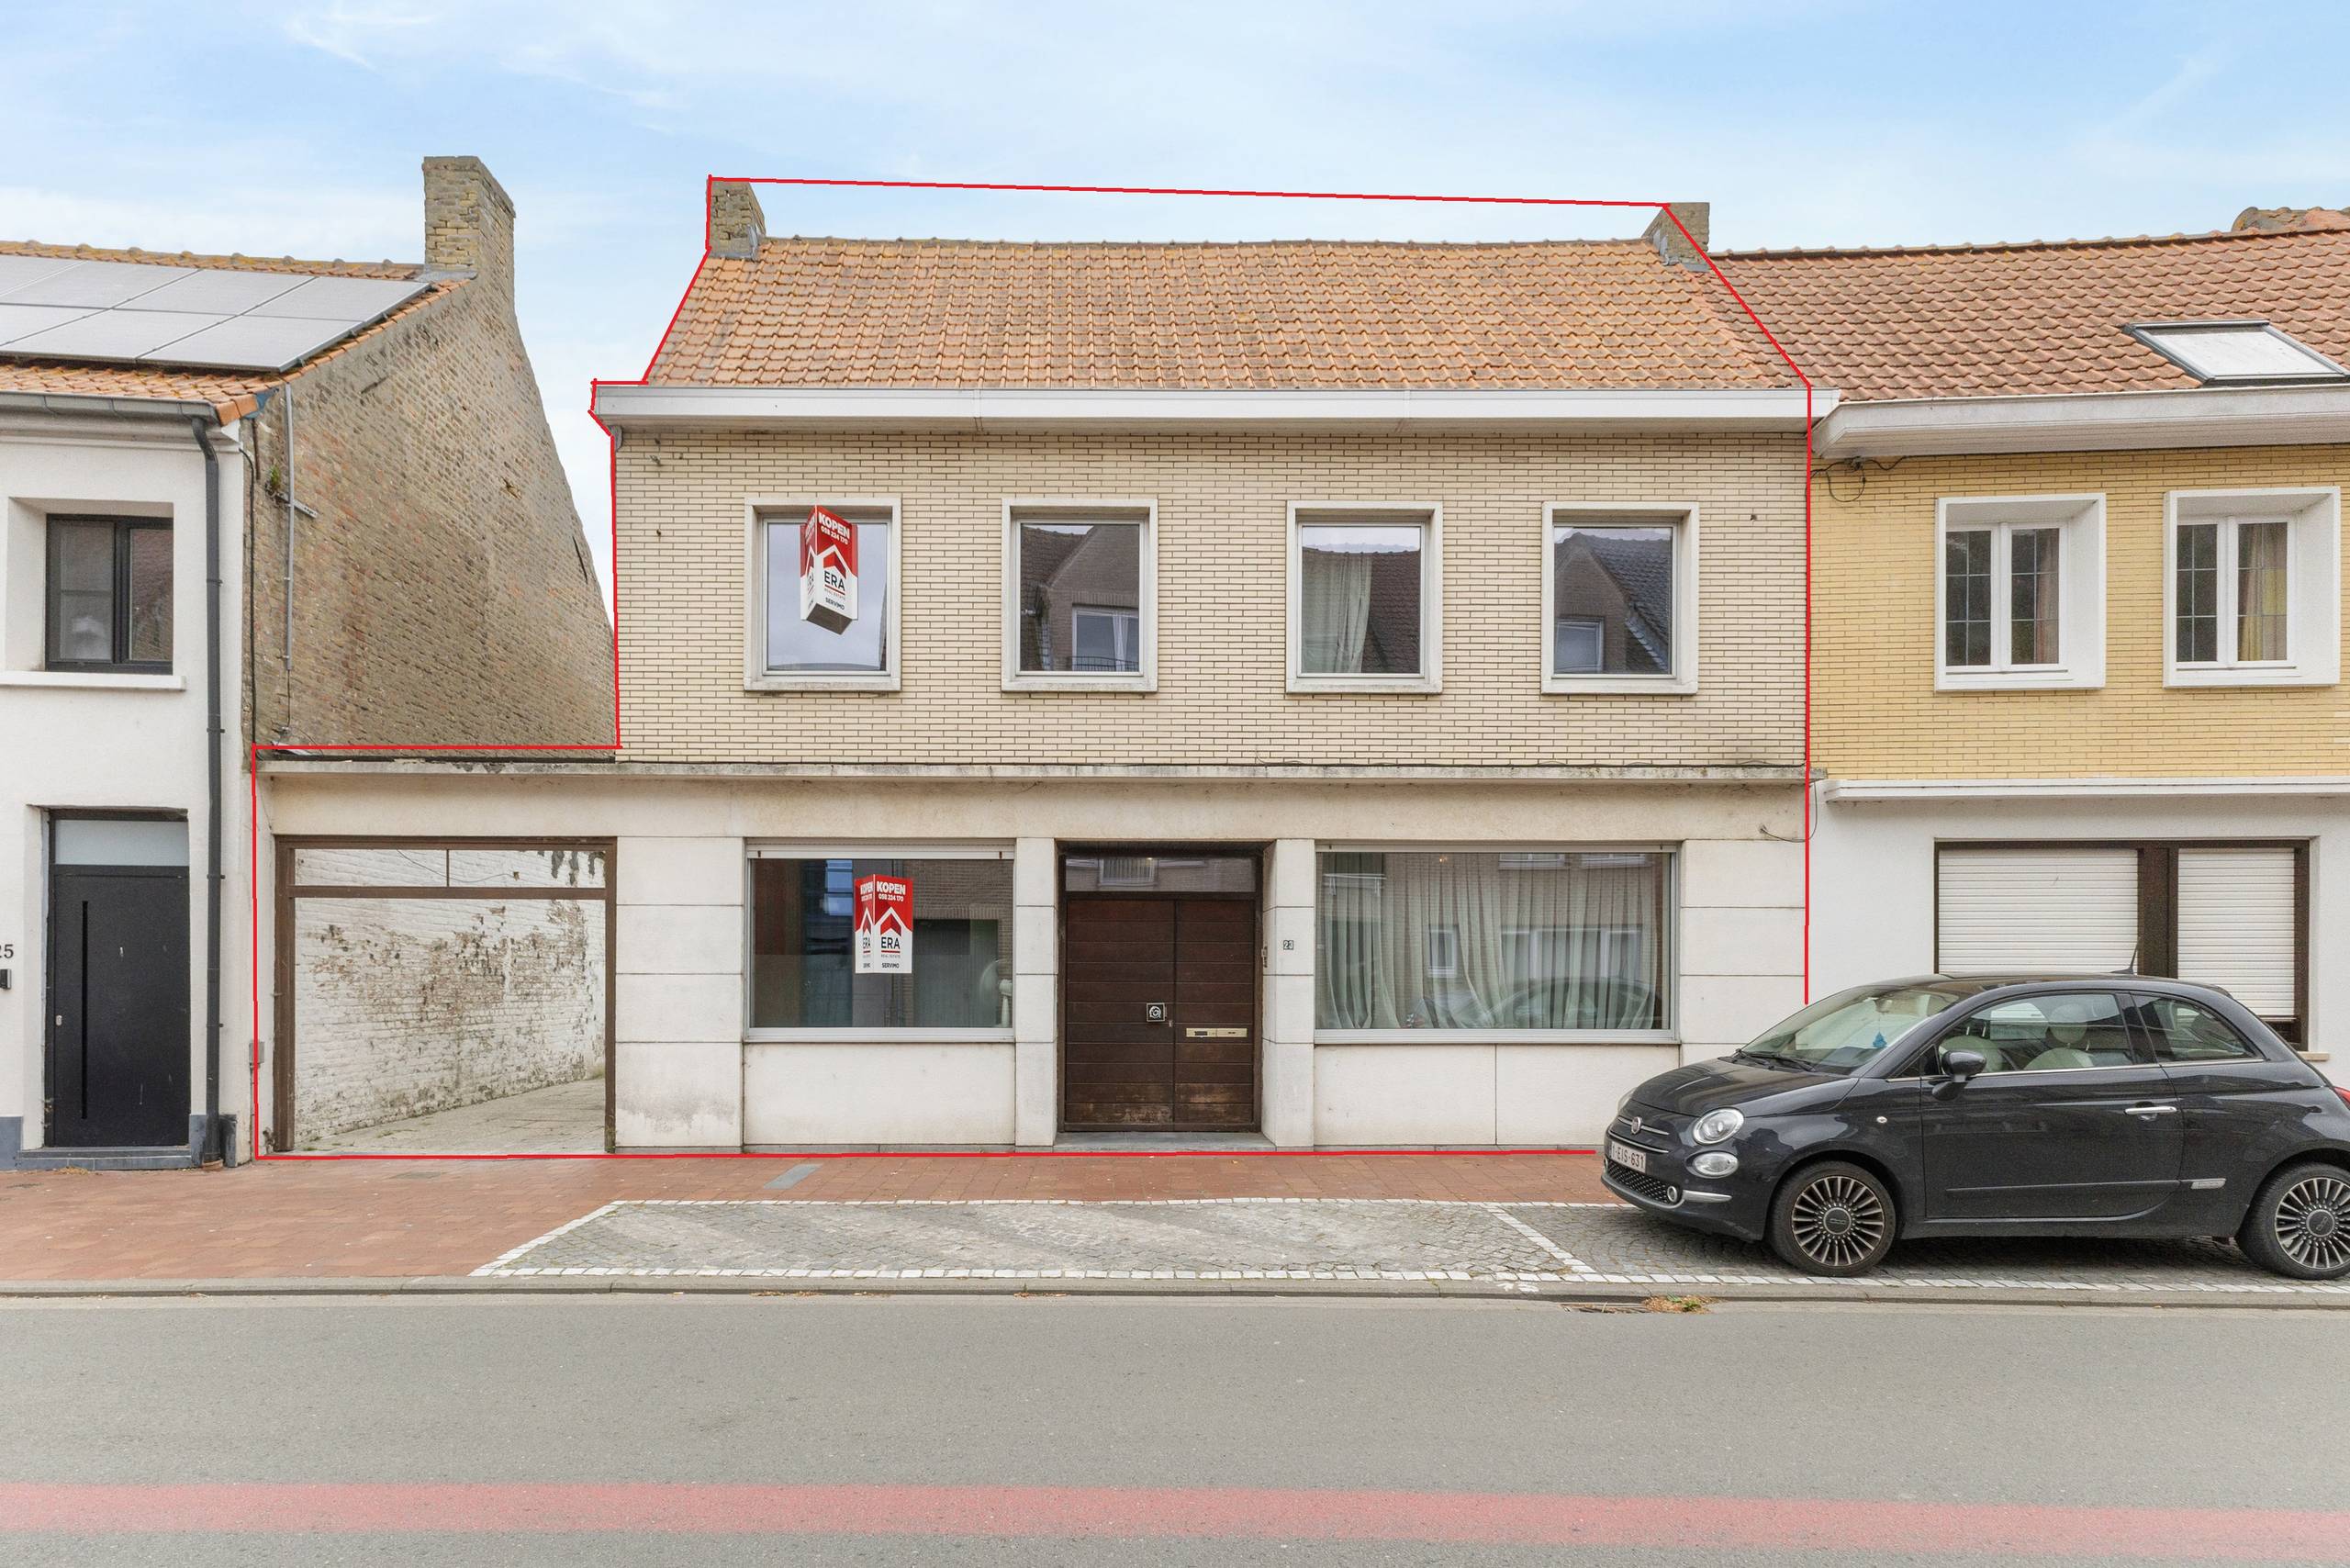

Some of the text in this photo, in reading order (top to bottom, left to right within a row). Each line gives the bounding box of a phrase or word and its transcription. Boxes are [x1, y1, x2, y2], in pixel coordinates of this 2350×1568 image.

[818, 511, 850, 540] KOPEN
[824, 570, 845, 592] ERA
[825, 597, 845, 610] SERVIMO
[877, 880, 906, 895] KOPEN
[880, 936, 901, 950] ERA
